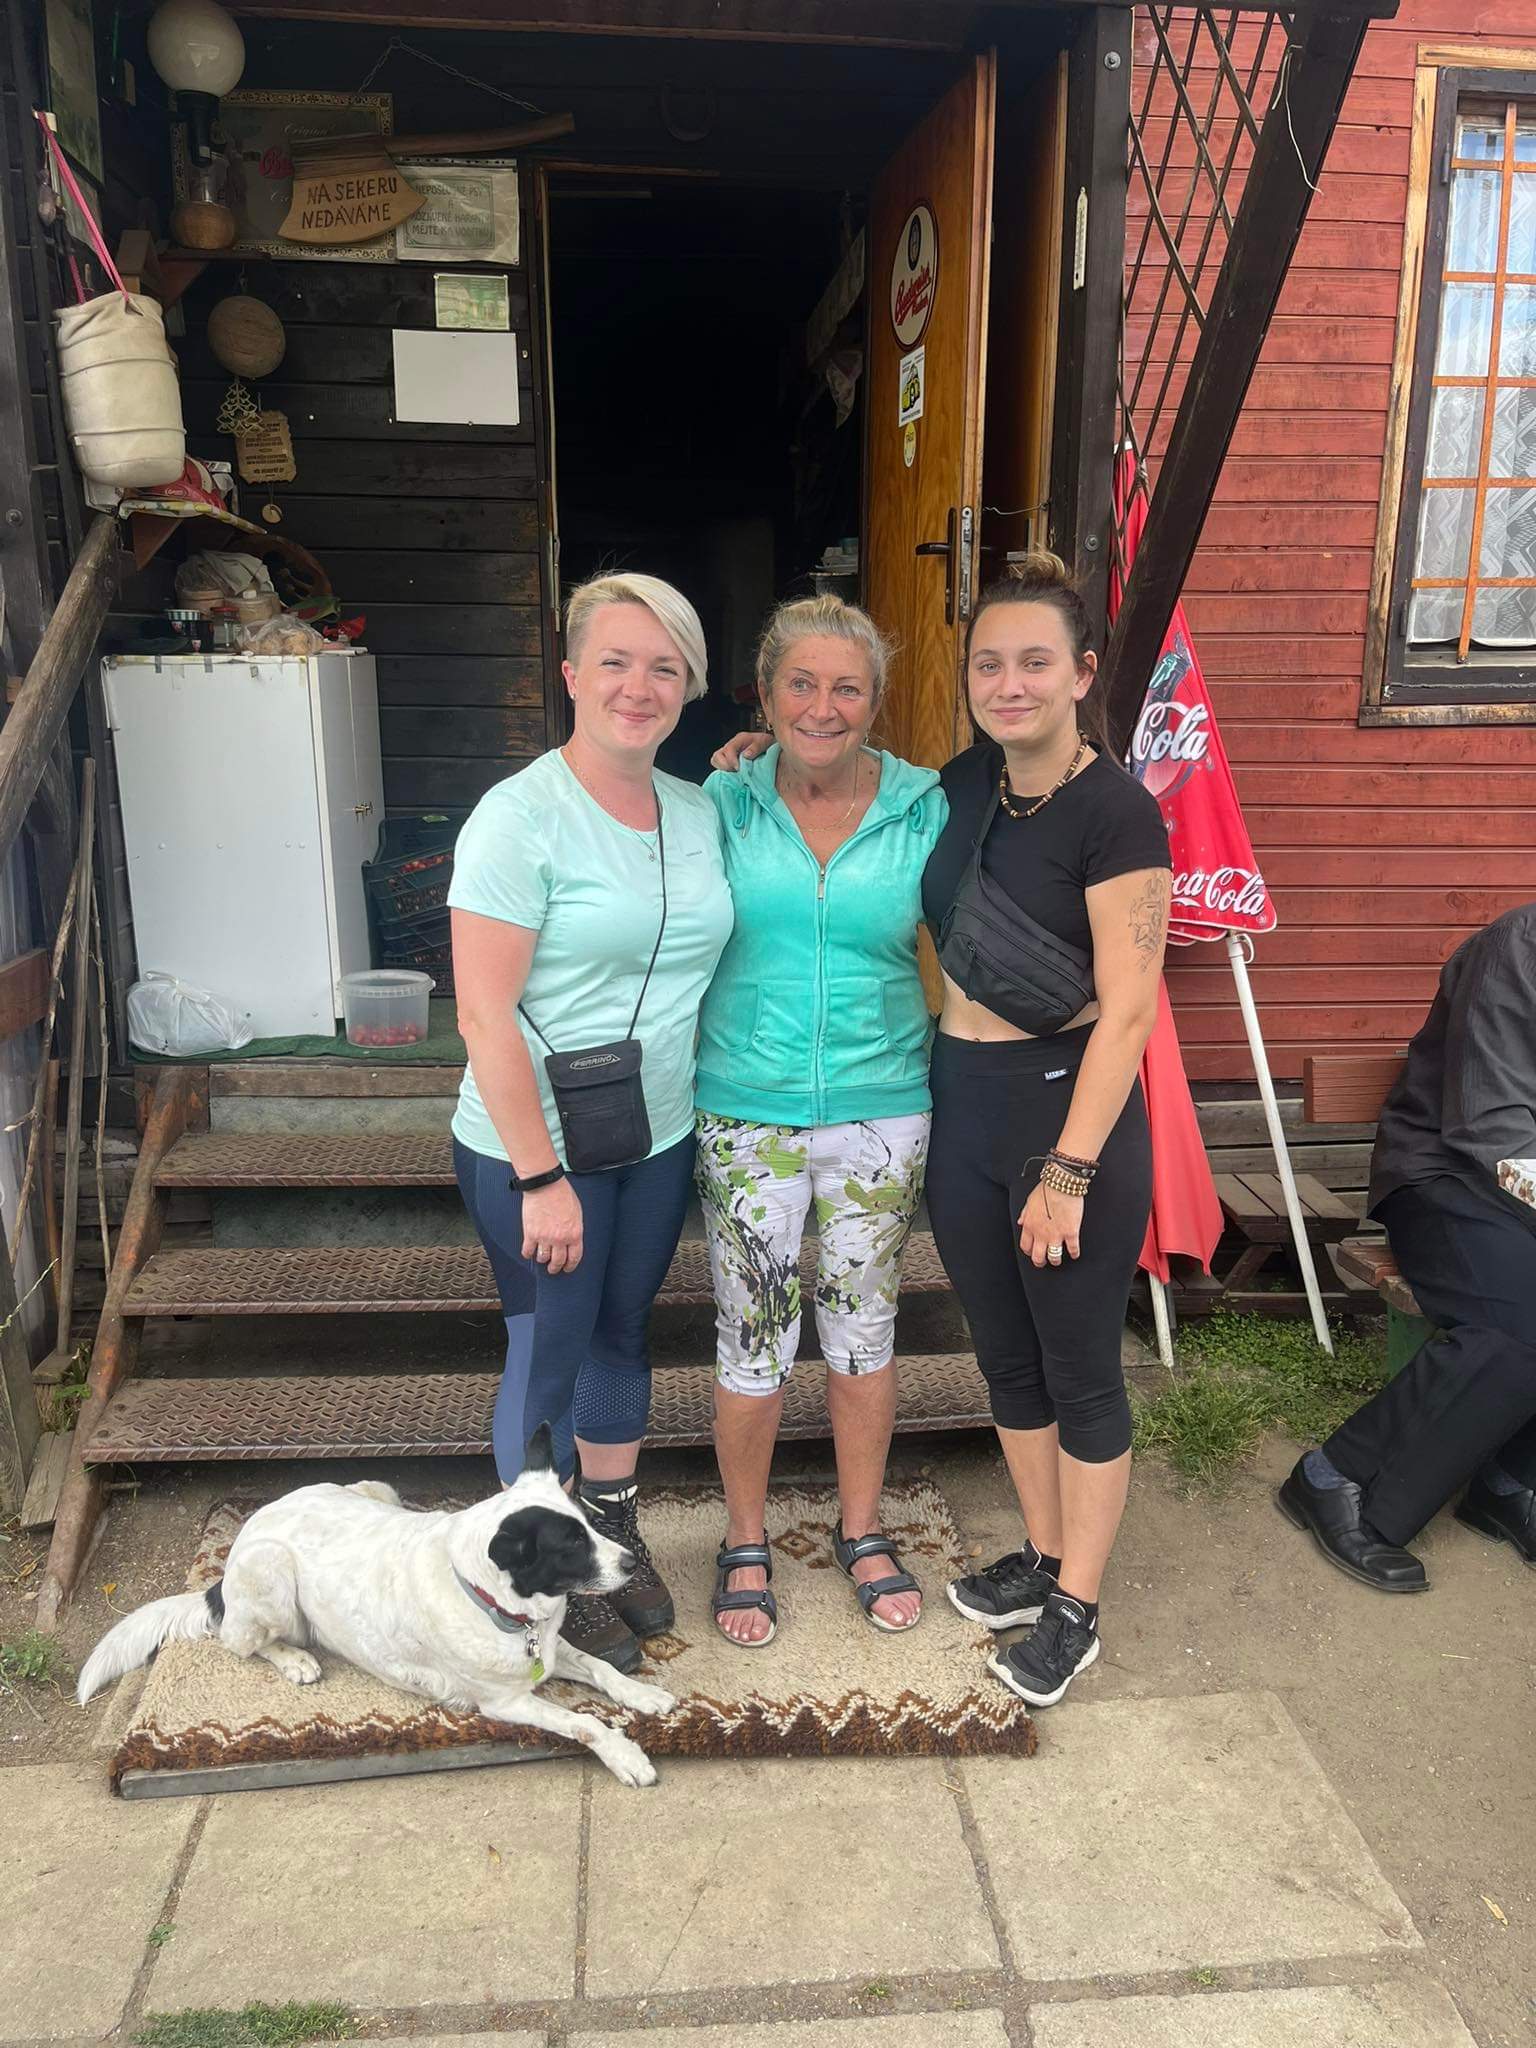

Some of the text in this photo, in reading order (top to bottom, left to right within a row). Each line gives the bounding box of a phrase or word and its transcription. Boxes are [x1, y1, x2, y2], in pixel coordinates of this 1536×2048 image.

[308, 183, 332, 205] NA
[335, 177, 397, 201] SEKERU
[302, 202, 391, 229] NEDÁVÁME
[1171, 867, 1265, 915] ca-Cola
